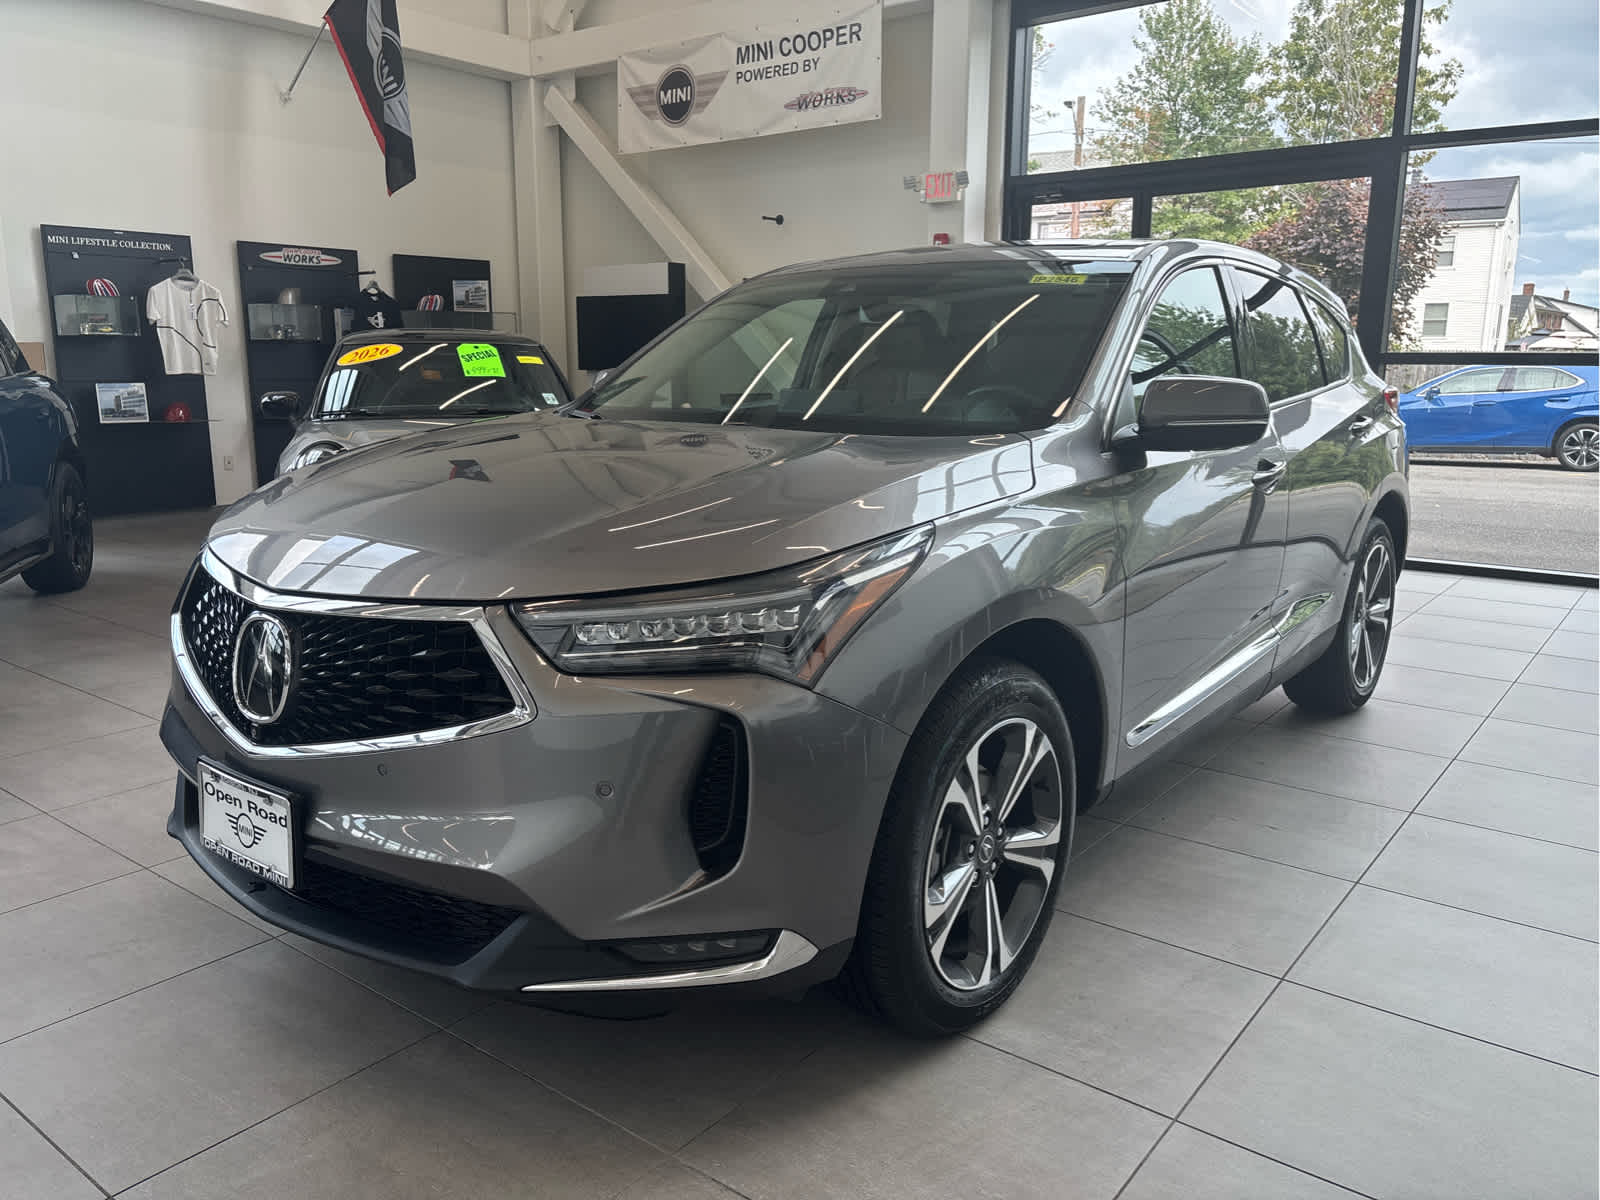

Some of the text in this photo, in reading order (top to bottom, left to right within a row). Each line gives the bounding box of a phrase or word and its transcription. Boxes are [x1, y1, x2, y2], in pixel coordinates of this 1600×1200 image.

[736, 22, 862, 65] MINI COOPER
[736, 57, 820, 85] POWERED BY
[660, 85, 691, 106] MINI
[797, 89, 857, 110] WORKS
[926, 172, 953, 199] EXIT
[47, 235, 174, 252] MINI LIFESTYLE COLLECTION.
[283, 254, 321, 265] WORKS
[347, 346, 389, 362] 2026
[461, 349, 497, 363] SPECIAL
[204, 782, 242, 808] Open
[247, 800, 287, 828] Road
[239, 824, 253, 838] MINI
[204, 839, 288, 886] OPEN ROAD MINI
